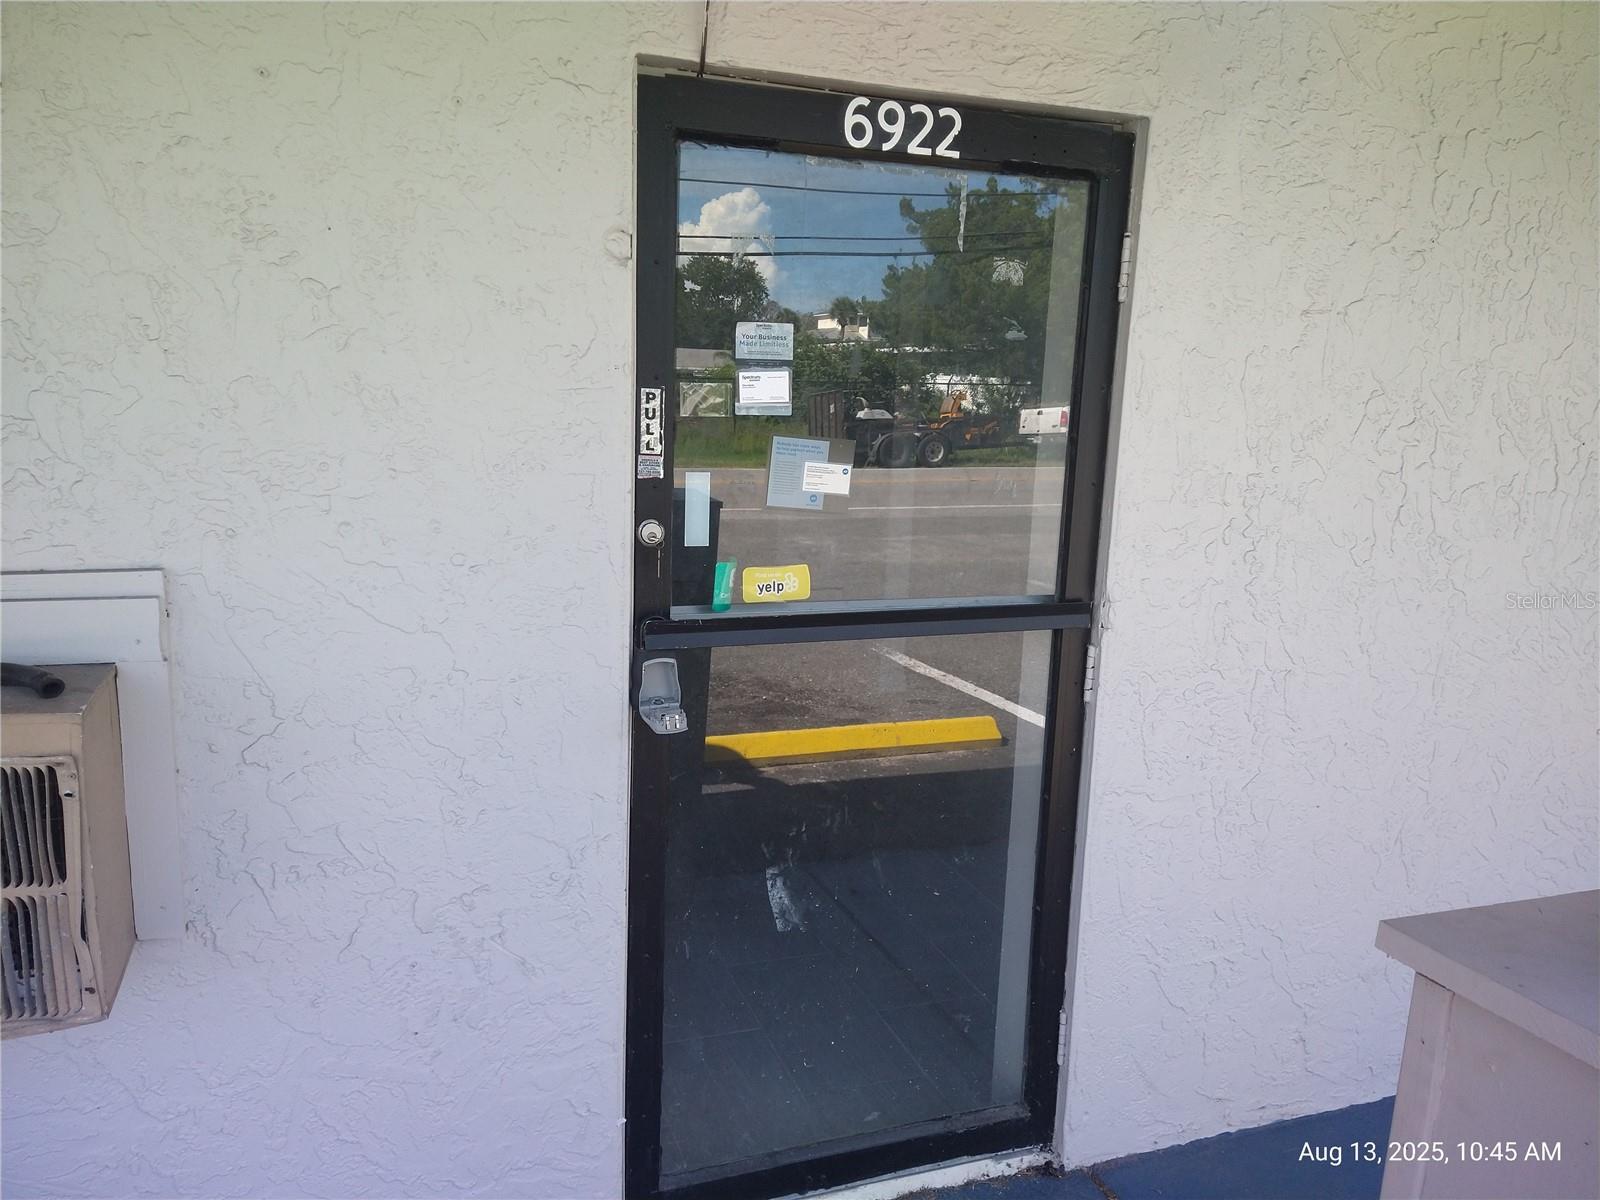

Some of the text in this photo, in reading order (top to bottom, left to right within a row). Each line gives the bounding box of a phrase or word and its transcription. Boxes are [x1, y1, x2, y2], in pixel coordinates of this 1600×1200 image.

[844, 96, 962, 159] 6922
[758, 333, 787, 341] Business
[645, 391, 656, 451] PULL
[757, 580, 784, 595] yelp
